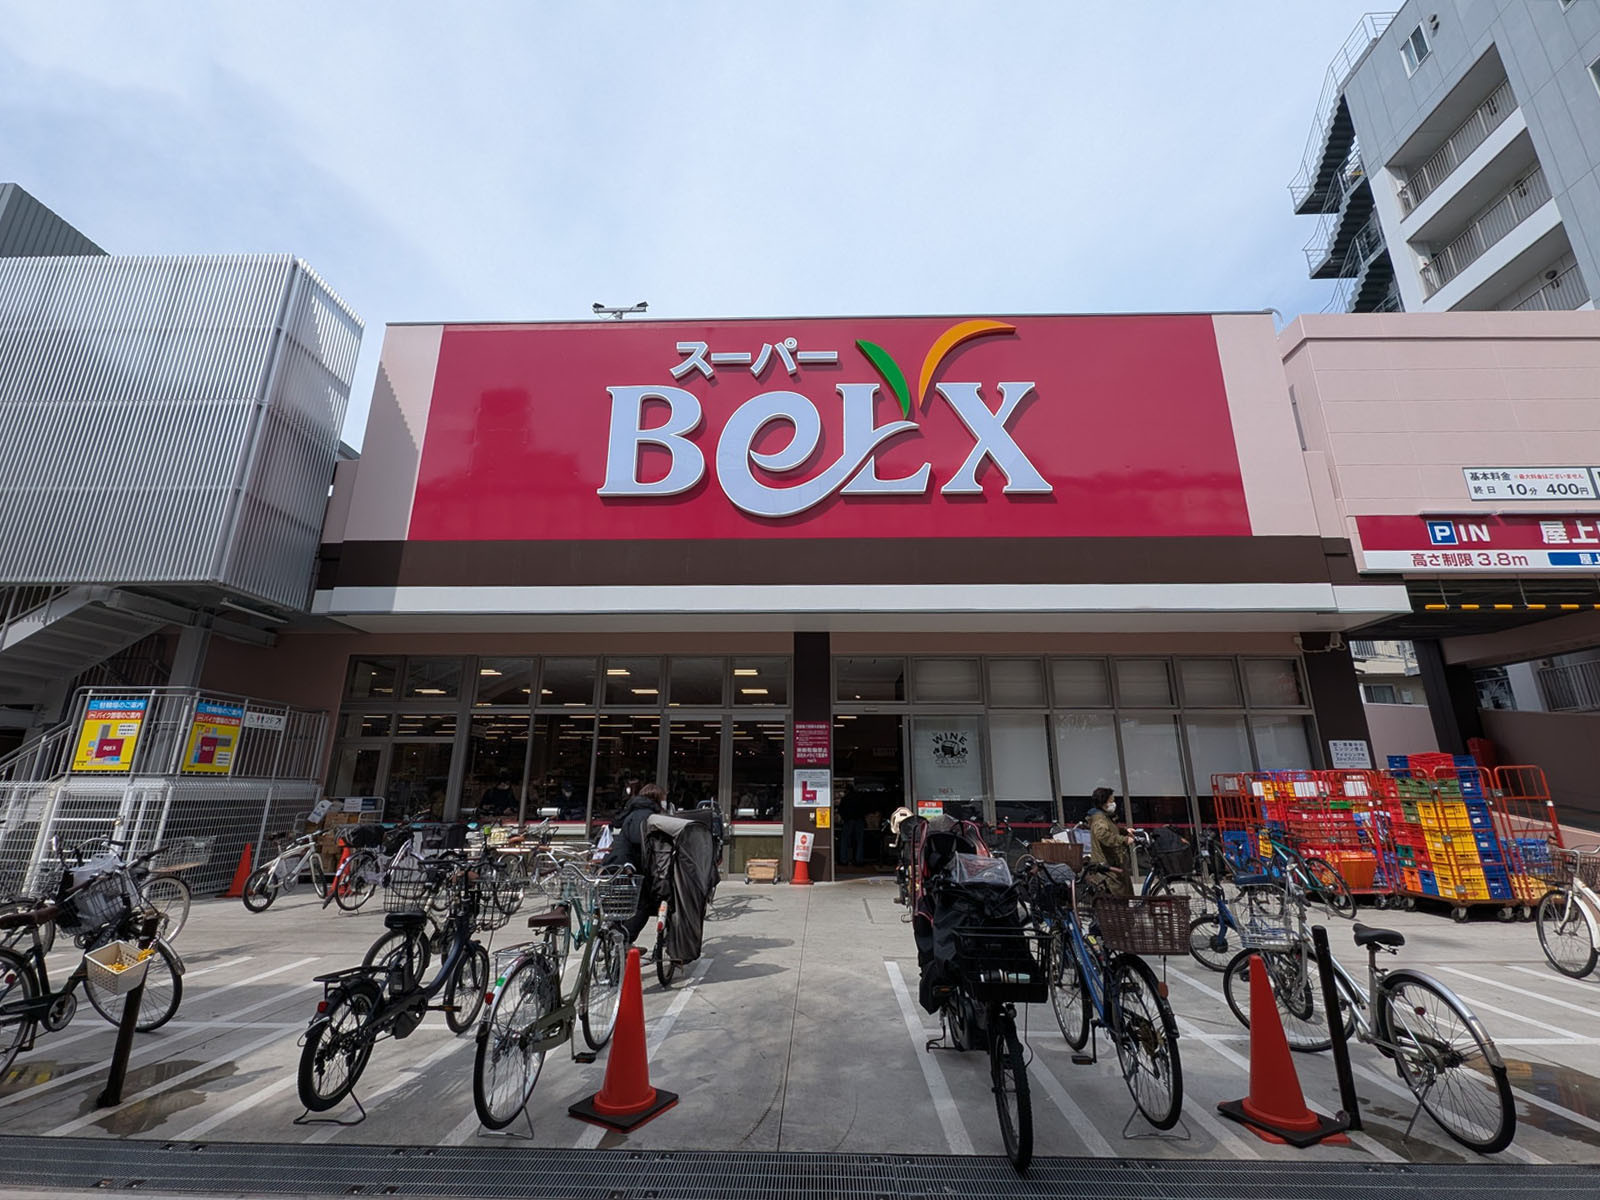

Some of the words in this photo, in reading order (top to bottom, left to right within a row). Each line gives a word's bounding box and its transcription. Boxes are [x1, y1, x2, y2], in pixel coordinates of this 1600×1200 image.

[670, 337, 839, 380] スーパー
[1469, 471, 1511, 482] 基本料金
[1473, 485, 1497, 495] 終日
[1506, 483, 1538, 496] 10分
[1546, 483, 1590, 496] 400円
[1459, 524, 1491, 542] IN
[1539, 520, 1600, 545] 屋上
[1410, 553, 1474, 568] 高さ制限
[1477, 552, 1529, 567] 3.8m
[932, 732, 968, 746] WINE
